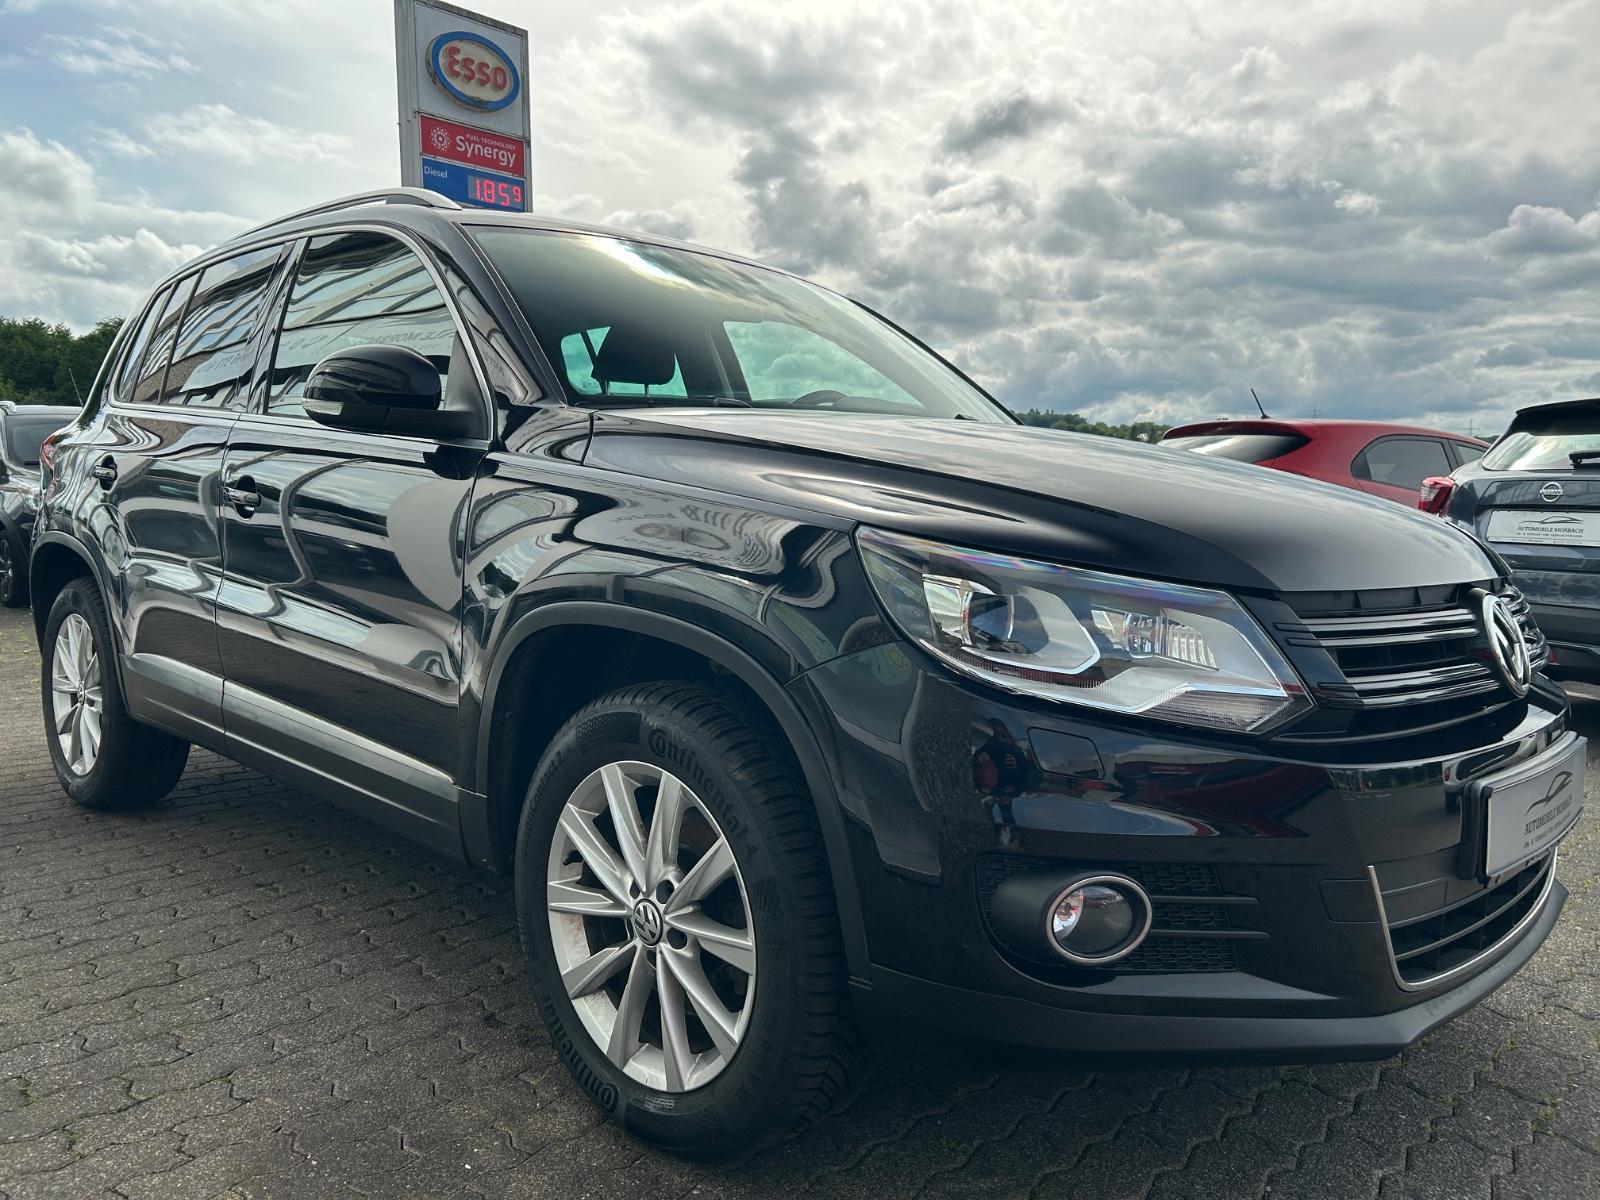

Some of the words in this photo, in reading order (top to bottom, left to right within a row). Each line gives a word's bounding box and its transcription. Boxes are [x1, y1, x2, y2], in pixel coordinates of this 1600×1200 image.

[455, 135, 517, 168] Synergy
[424, 165, 448, 179] Diesel
[648, 728, 750, 840] Continental
